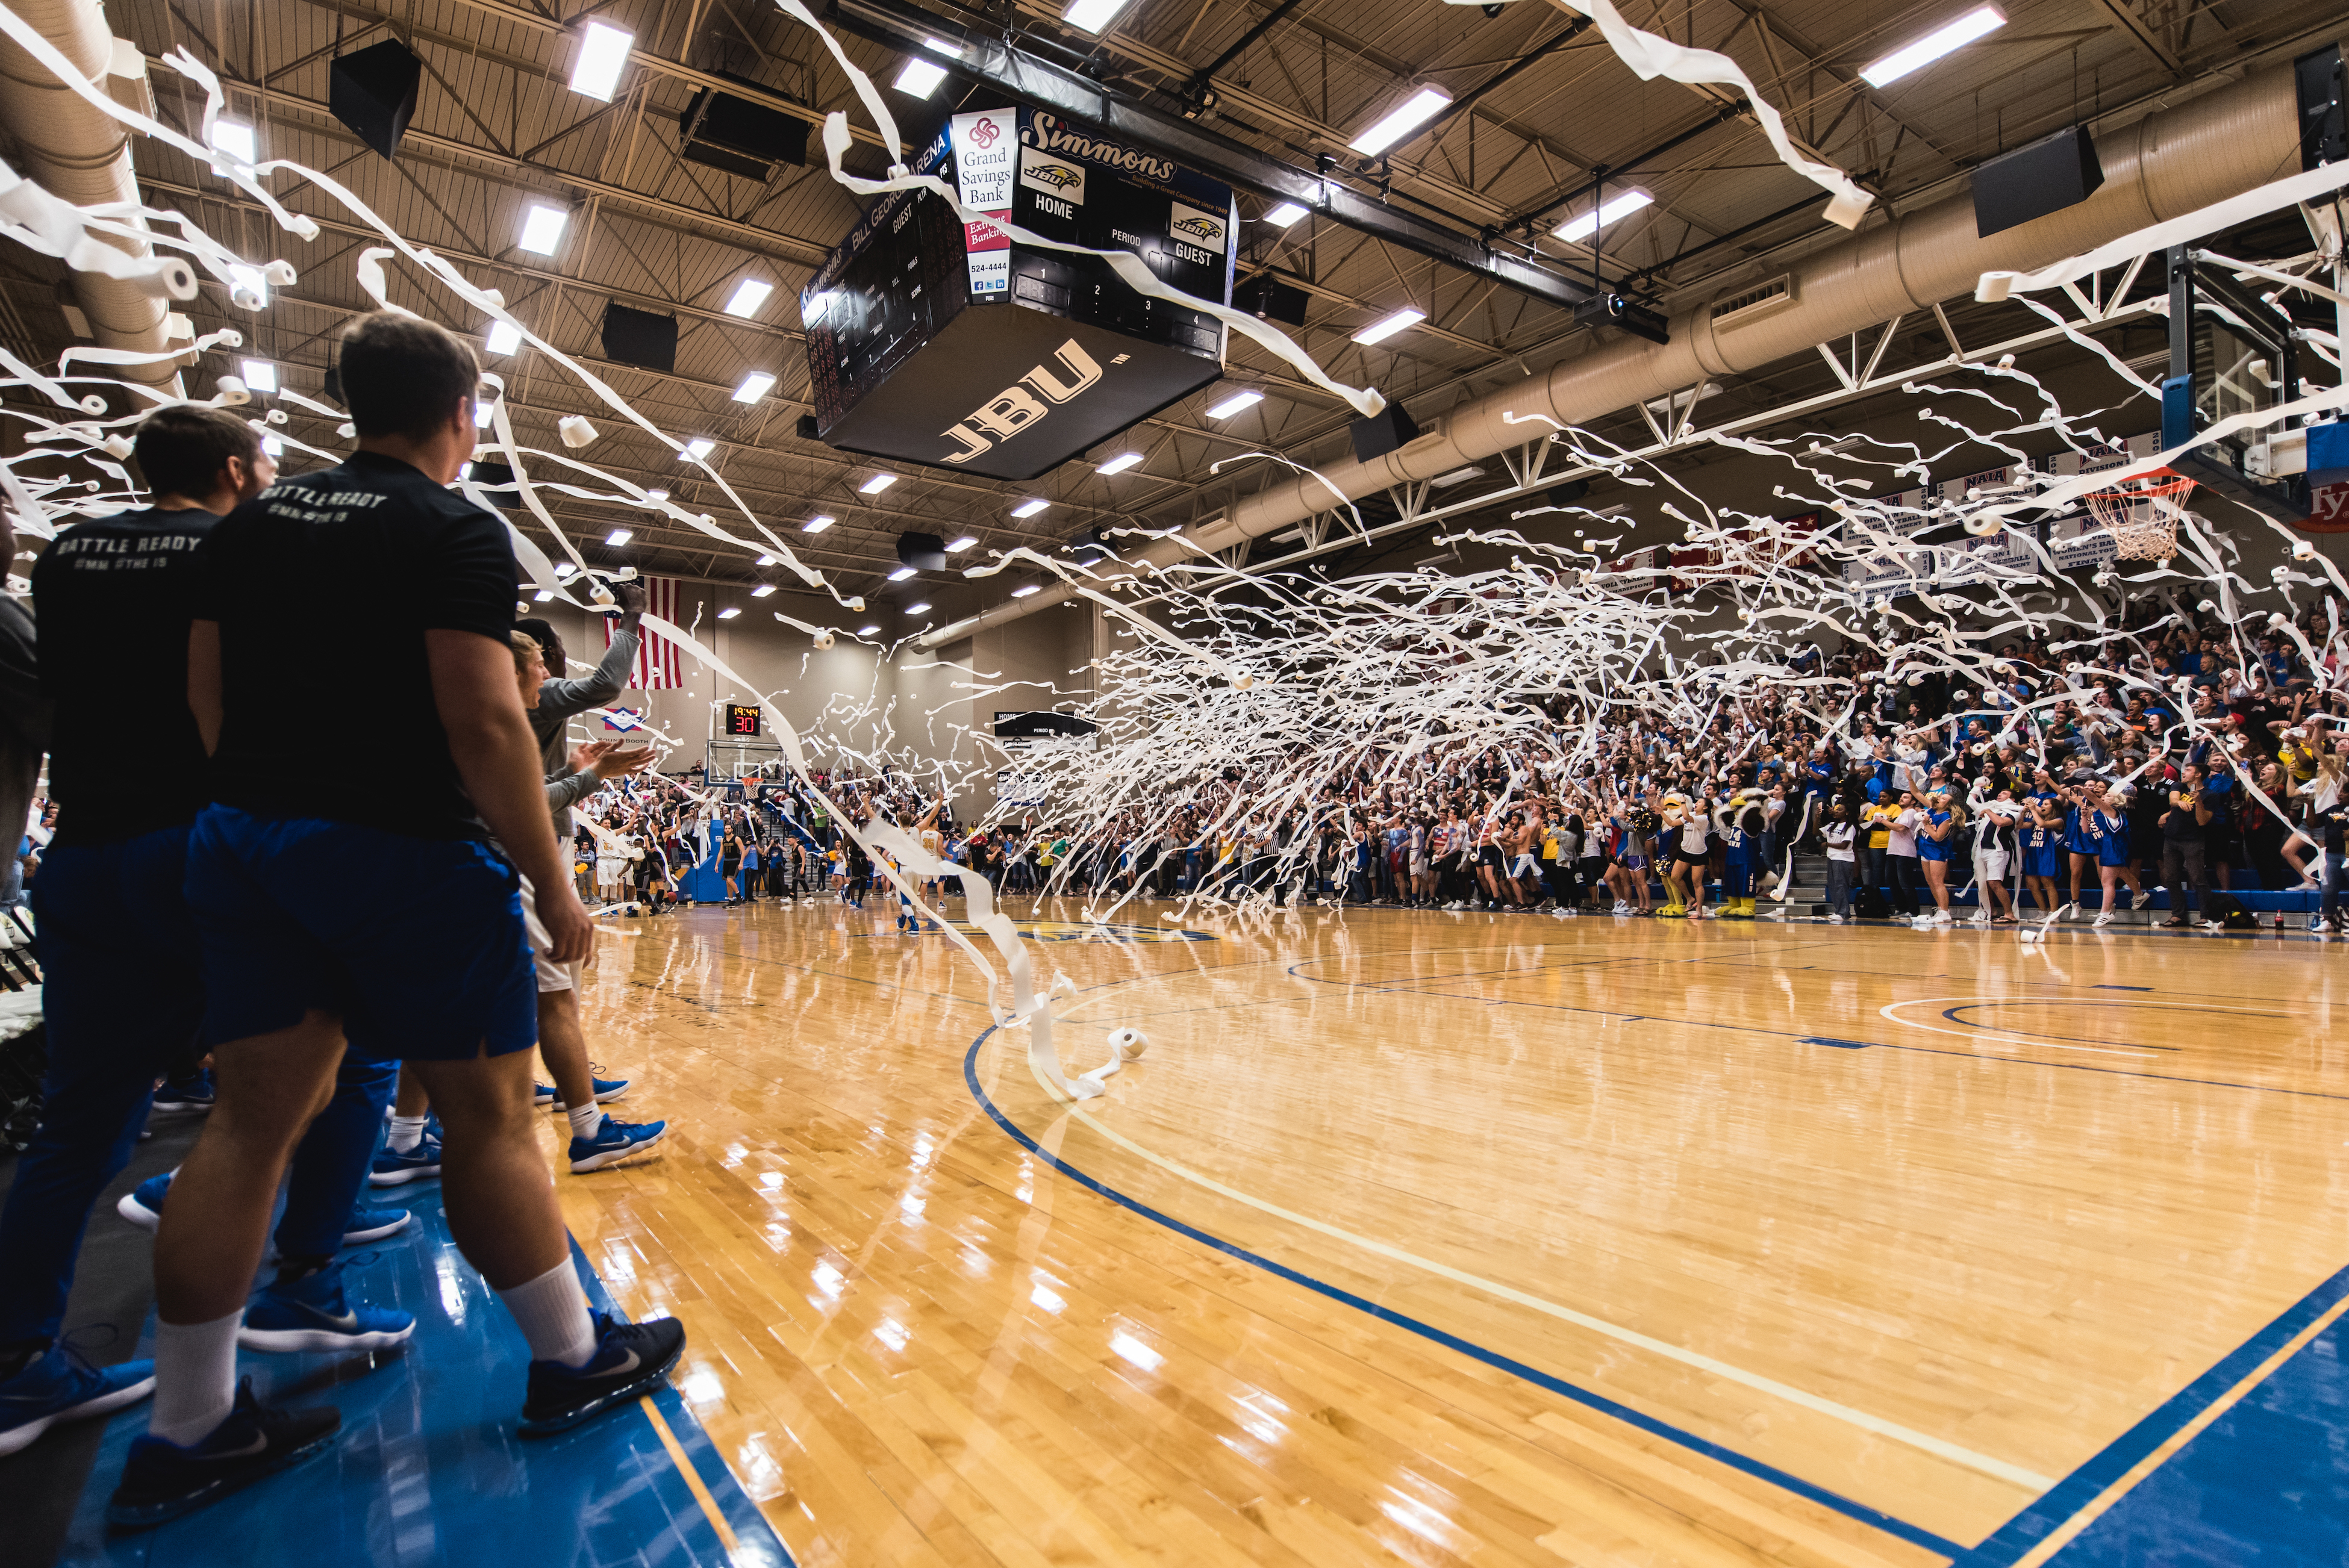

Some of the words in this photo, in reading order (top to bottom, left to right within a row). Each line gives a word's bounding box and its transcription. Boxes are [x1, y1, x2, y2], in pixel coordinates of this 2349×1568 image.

[1021, 111, 1173, 179] Simmons
[964, 147, 1006, 166] Grand
[940, 163, 948, 179] PTS
[962, 170, 1011, 186] Savings
[1025, 166, 1063, 184] JBU
[1117, 176, 1143, 189] DAKTRONICS
[851, 222, 871, 252] BILL
[871, 189, 907, 228] GEORG
[909, 134, 946, 176] ARENA
[917, 187, 927, 204] PLYR
[970, 186, 1004, 204] Bank
[1132, 174, 1155, 190] Building
[1160, 185, 1175, 196] Great
[1176, 191, 1200, 206] Company
[1201, 201, 1215, 211] since
[1215, 205, 1228, 215] 1949
[1035, 193, 1073, 220] HOME
[893, 202, 912, 234] GUEST
[1173, 218, 1206, 235] JBU
[1112, 228, 1141, 247] PERIOD
[1175, 243, 1212, 267] GUEST
[907, 256, 918, 272] FOULS
[971, 263, 1007, 273] 524-4444
[1041, 269, 1046, 279] 1
[1094, 285, 1100, 295] 2
[1146, 300, 1151, 311] 3
[912, 312, 916, 322] 4
[1193, 315, 1199, 325] 4
[889, 334, 894, 343] 3
[868, 353, 873, 363] 2
[849, 373, 853, 381] 1
[938, 337, 1103, 464] JBU
[2079, 461, 2124, 475] DIVISION
[1966, 469, 2005, 493] NAIA
[257, 485, 328, 507] BATTLE
[327, 491, 388, 509] READY
[57, 538, 129, 556] BATTLE
[136, 535, 202, 553] READY
[2059, 550, 2098, 561] NATIONAL
[2068, 557, 2104, 567] FINAL
[734, 707, 758, 717] 19:44
[736, 717, 754, 733] 30
[923, 838, 935, 850] 35
[2032, 831, 2044, 841] 40
